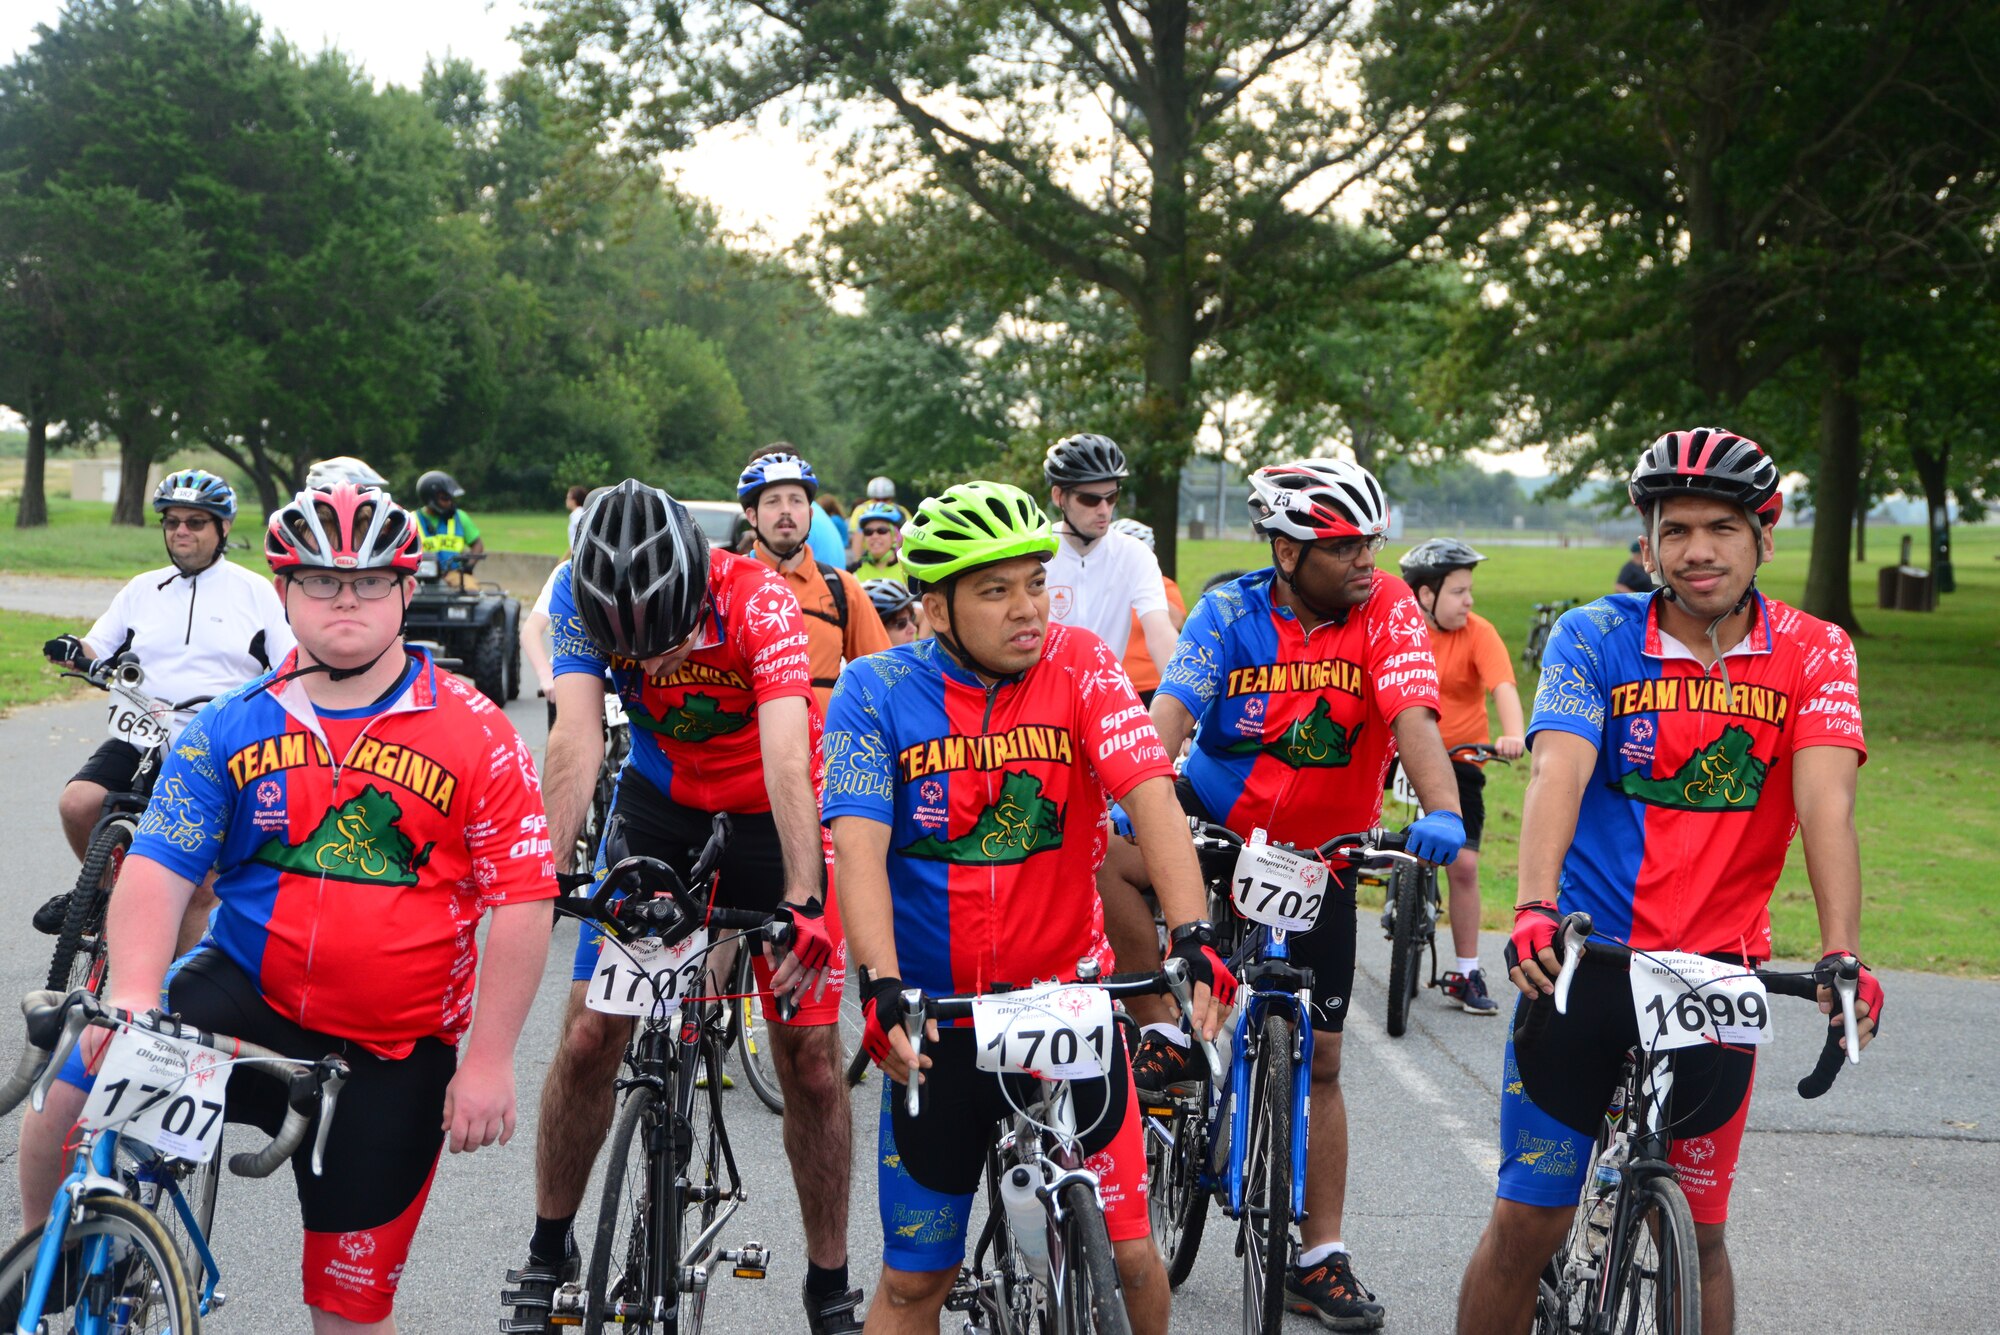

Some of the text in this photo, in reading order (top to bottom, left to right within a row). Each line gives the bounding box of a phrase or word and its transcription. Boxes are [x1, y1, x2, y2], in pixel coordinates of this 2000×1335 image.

[1273, 491, 1293, 507] 25
[335, 558, 355, 566] BELL
[1226, 659, 1364, 699] TEAM VIRGNIA
[1611, 679, 1681, 719] TEAM
[1235, 722, 1265, 734] Olympics
[1239, 717, 1263, 728] Special
[1624, 741, 1655, 753] Special
[899, 725, 1073, 784] TEAM VIRGINIA
[1619, 748, 1656, 761] Olympics
[1627, 757, 1648, 765] Virginia
[227, 731, 308, 793] TEAM
[254, 809, 286, 818] Special
[916, 805, 947, 815] Special
[252, 817, 291, 826] Olympics
[912, 813, 950, 823] Olympics
[921, 821, 942, 829] Virginia
[261, 824, 284, 832] Virginia
[1256, 856, 1296, 874] Olympics
[1266, 851, 1299, 867] Special
[1265, 867, 1293, 881] Delaware
[1237, 876, 1322, 922] 1702
[1661, 957, 1704, 966] Special
[1651, 966, 1705, 976] Olympics
[1645, 991, 1768, 1036] 1699
[152, 1041, 190, 1058] Special
[987, 1025, 1104, 1070] 1701
[136, 1047, 187, 1069] Olympics
[104, 1077, 223, 1142] 1707
[1675, 1162, 1715, 1178] Special
[1679, 1173, 1718, 1187] ympics
[1099, 1183, 1120, 1194] cial
[1102, 1193, 1126, 1204] pics
[330, 1259, 374, 1276] Special
[324, 1266, 376, 1287] Olympics
[335, 1279, 362, 1294] Virginia
